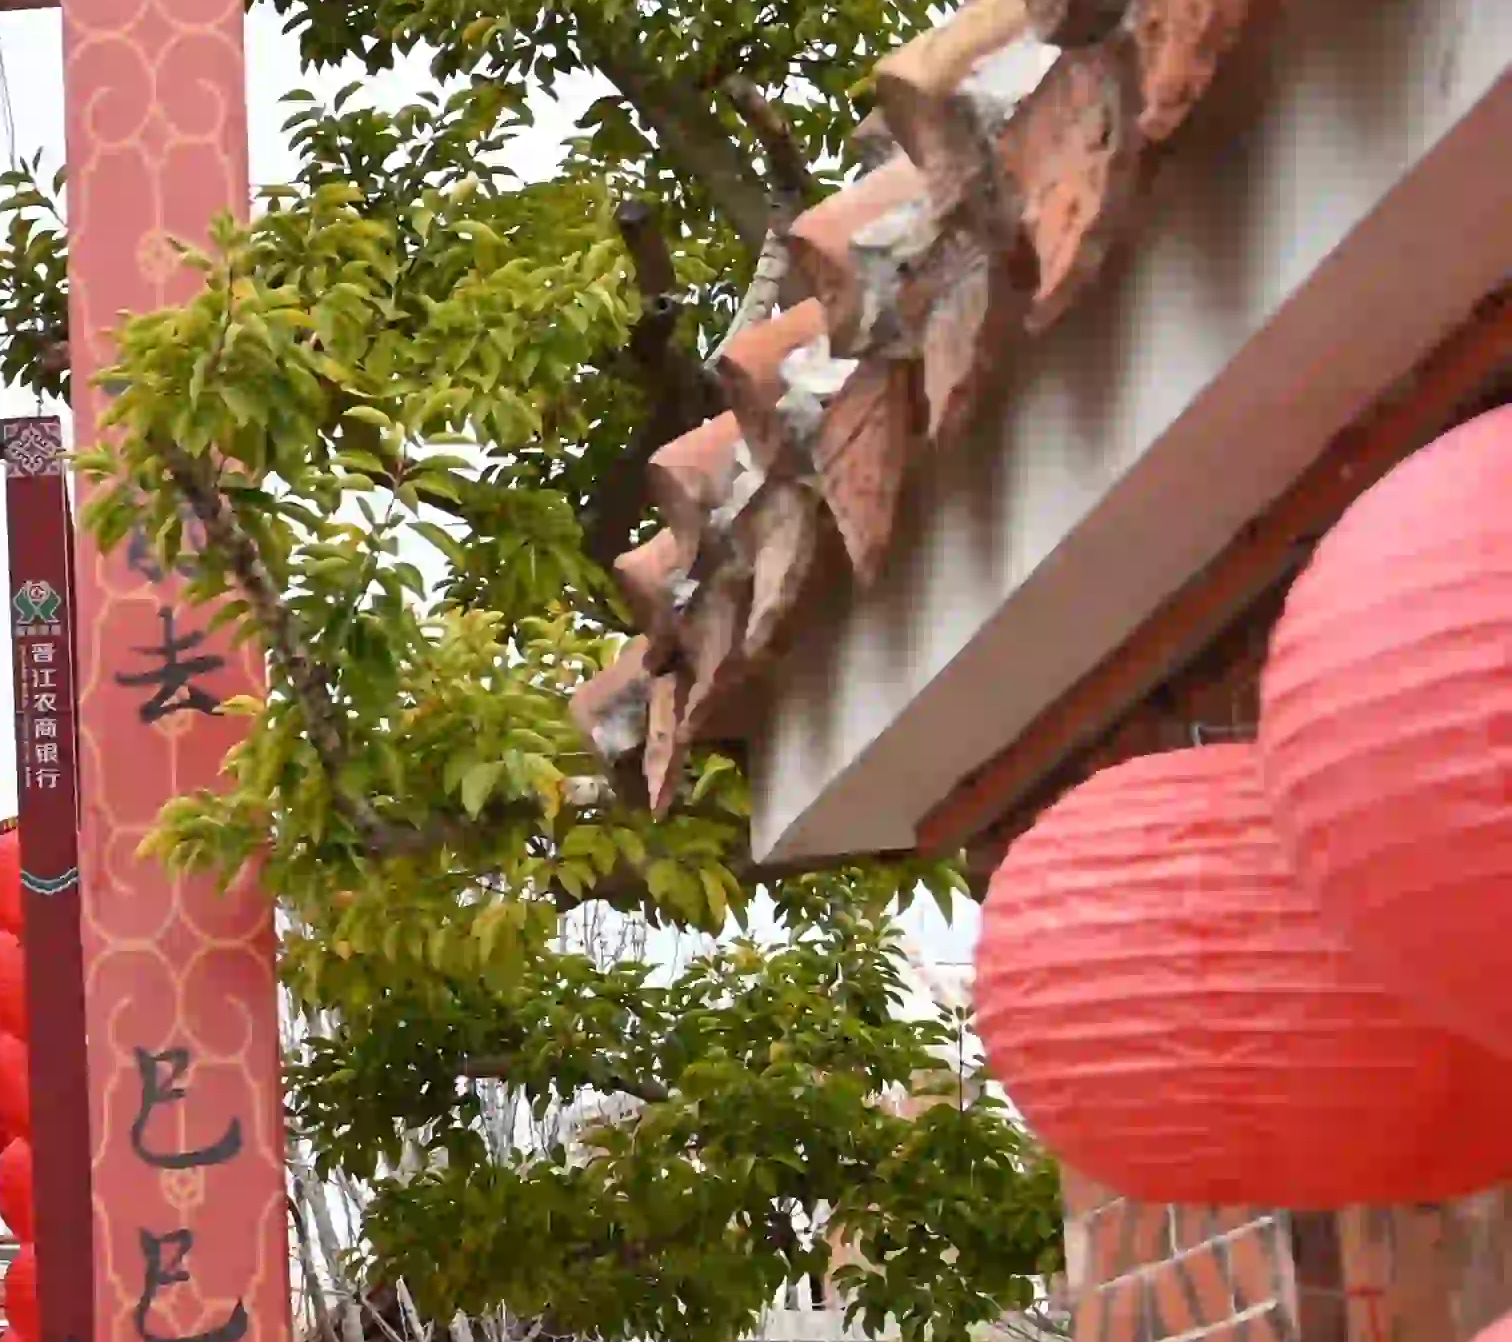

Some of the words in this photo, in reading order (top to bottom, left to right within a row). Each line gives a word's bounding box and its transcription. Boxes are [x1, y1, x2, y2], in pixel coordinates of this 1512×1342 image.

[31, 642, 60, 789] 晋江农商银行
